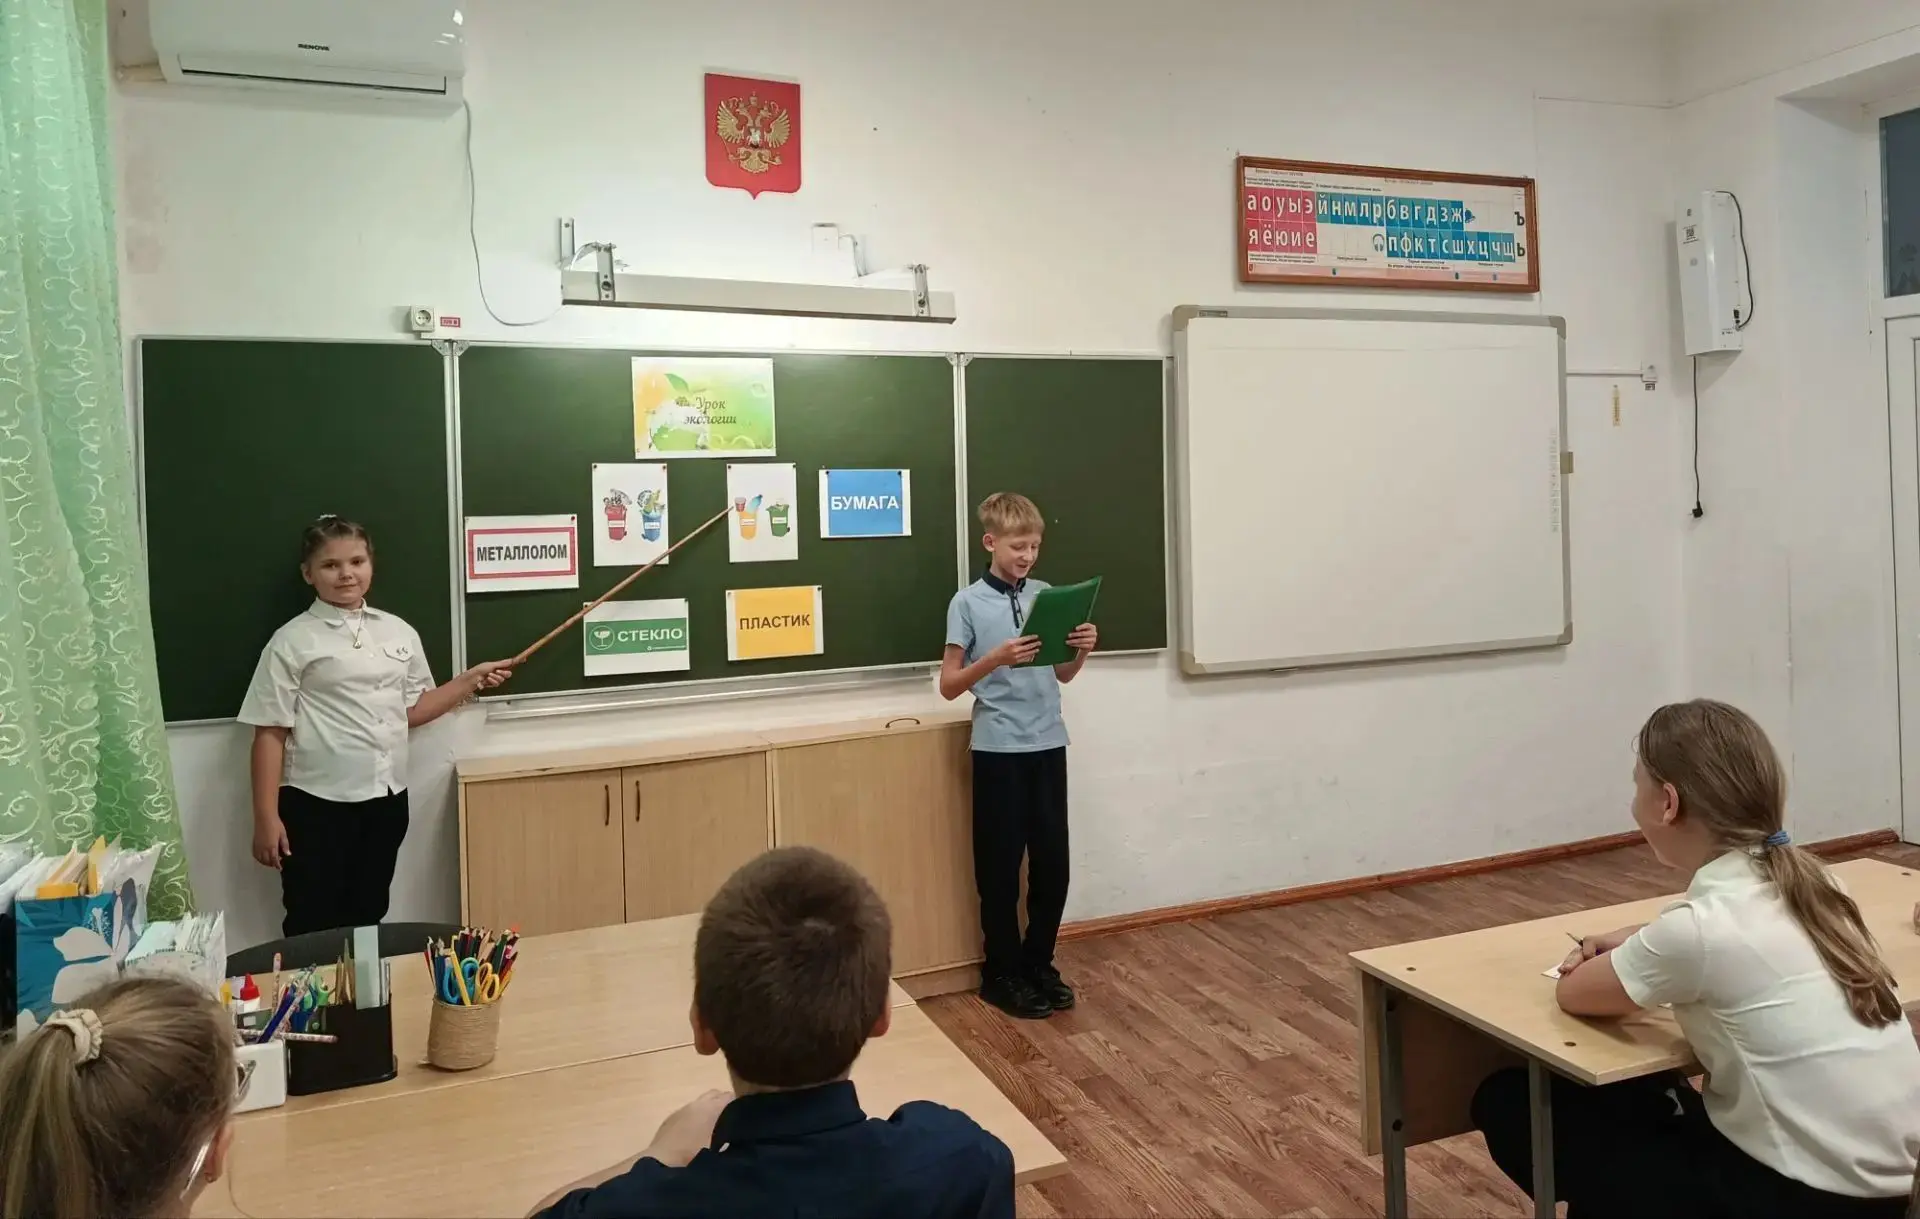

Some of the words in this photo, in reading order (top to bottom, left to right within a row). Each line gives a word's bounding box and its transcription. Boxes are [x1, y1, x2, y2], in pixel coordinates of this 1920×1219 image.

[696, 397, 726, 414] Урок
[684, 415, 737, 425] экологии
[831, 495, 899, 510] БУМАГА
[476, 544, 568, 562] МЕТАЛЛОЛОМ
[739, 614, 811, 630] ПЛАСТИК
[617, 628, 683, 642] СТЕКЛО
